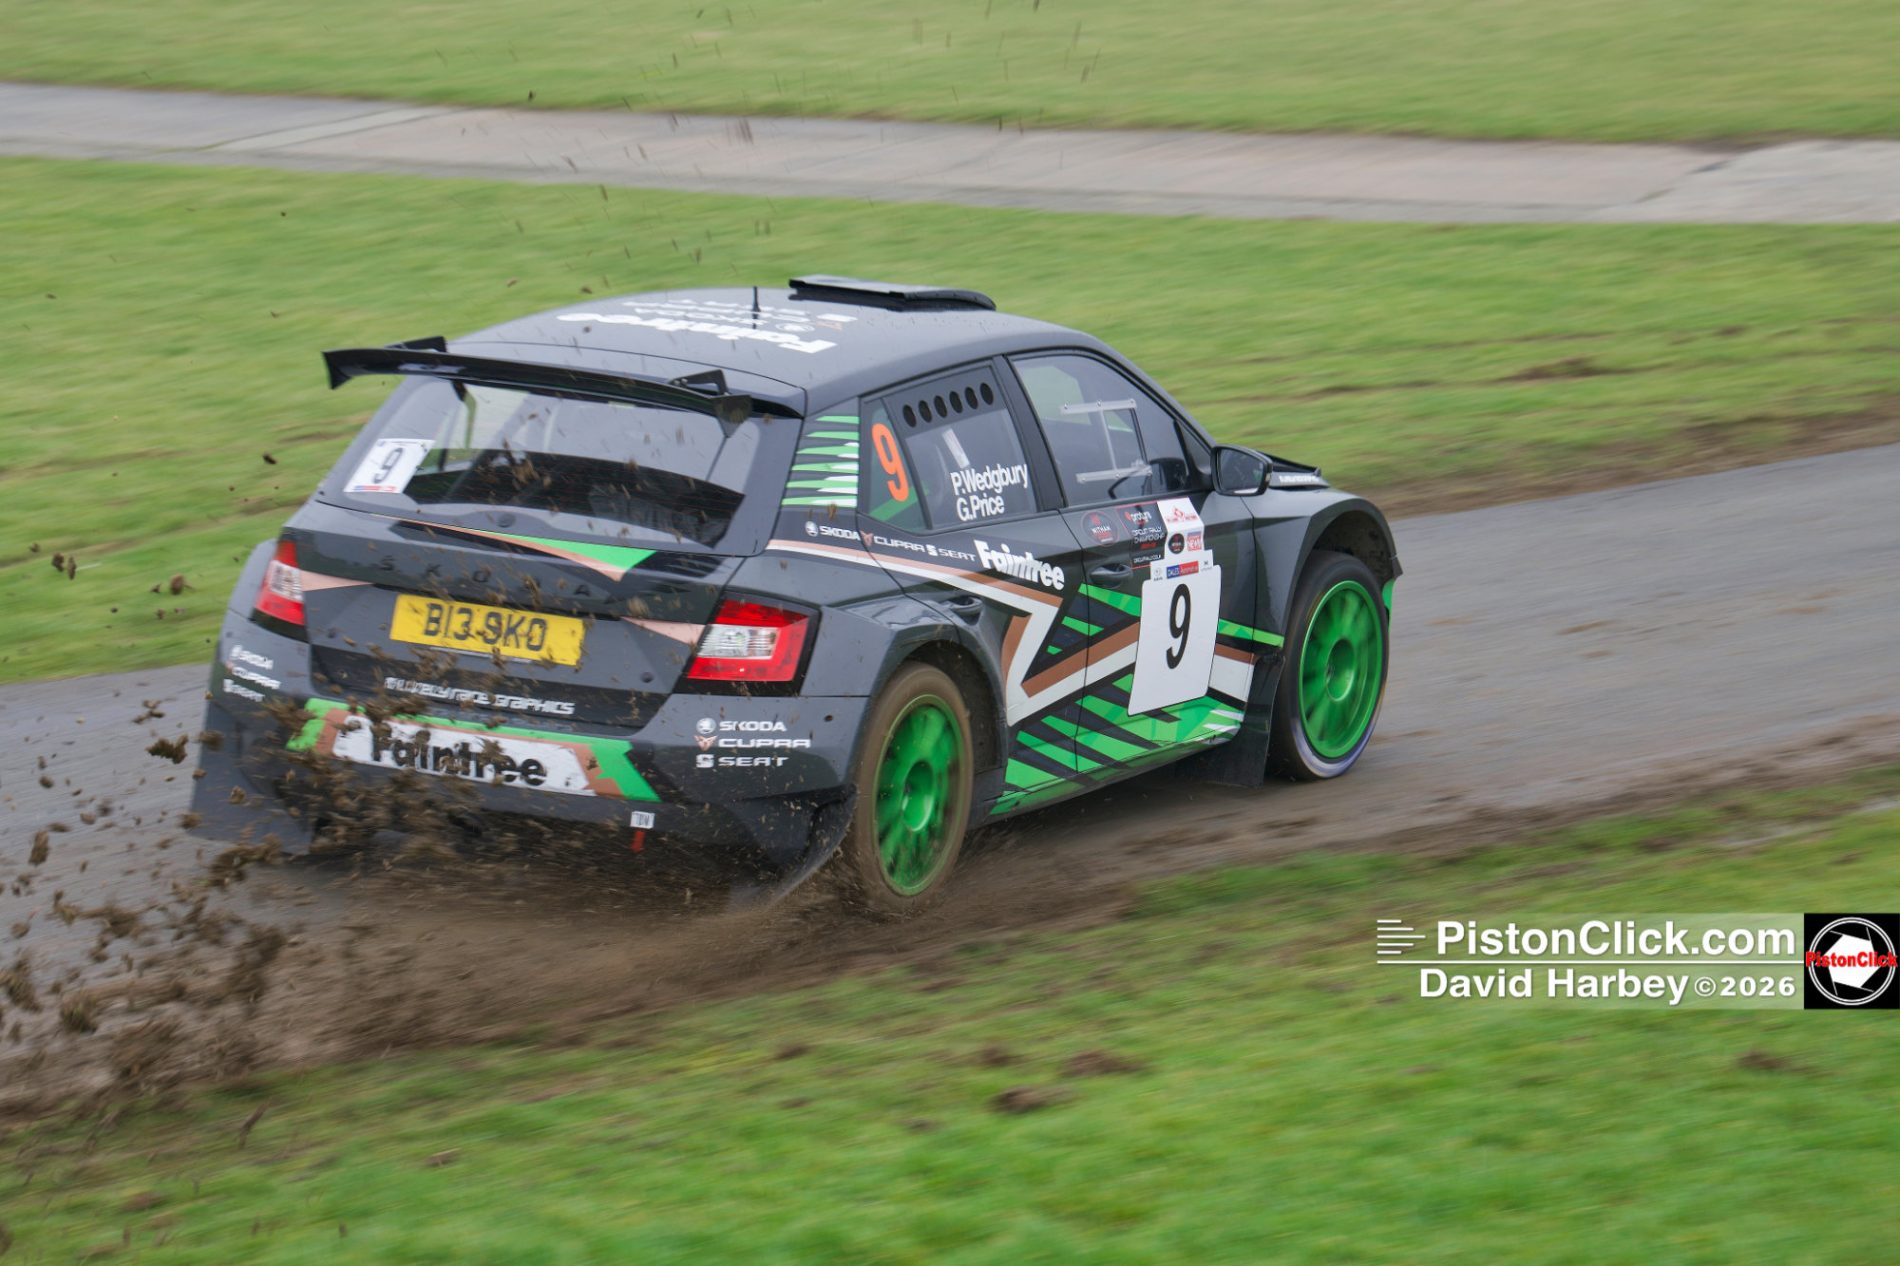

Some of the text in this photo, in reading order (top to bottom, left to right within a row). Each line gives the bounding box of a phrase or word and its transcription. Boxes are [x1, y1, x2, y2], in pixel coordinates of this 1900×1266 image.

[372, 447, 404, 484] 9
[871, 423, 909, 502] 9
[950, 463, 1029, 496] P.Wedgbury
[956, 492, 1005, 522] G.Price
[819, 525, 976, 563] SKODA CUPRA SEAT
[974, 539, 1065, 591] Faintree
[1166, 583, 1191, 670] 9
[718, 738, 811, 749] CUPRA
[719, 720, 787, 732] SKODA
[718, 756, 789, 767] SEAT
